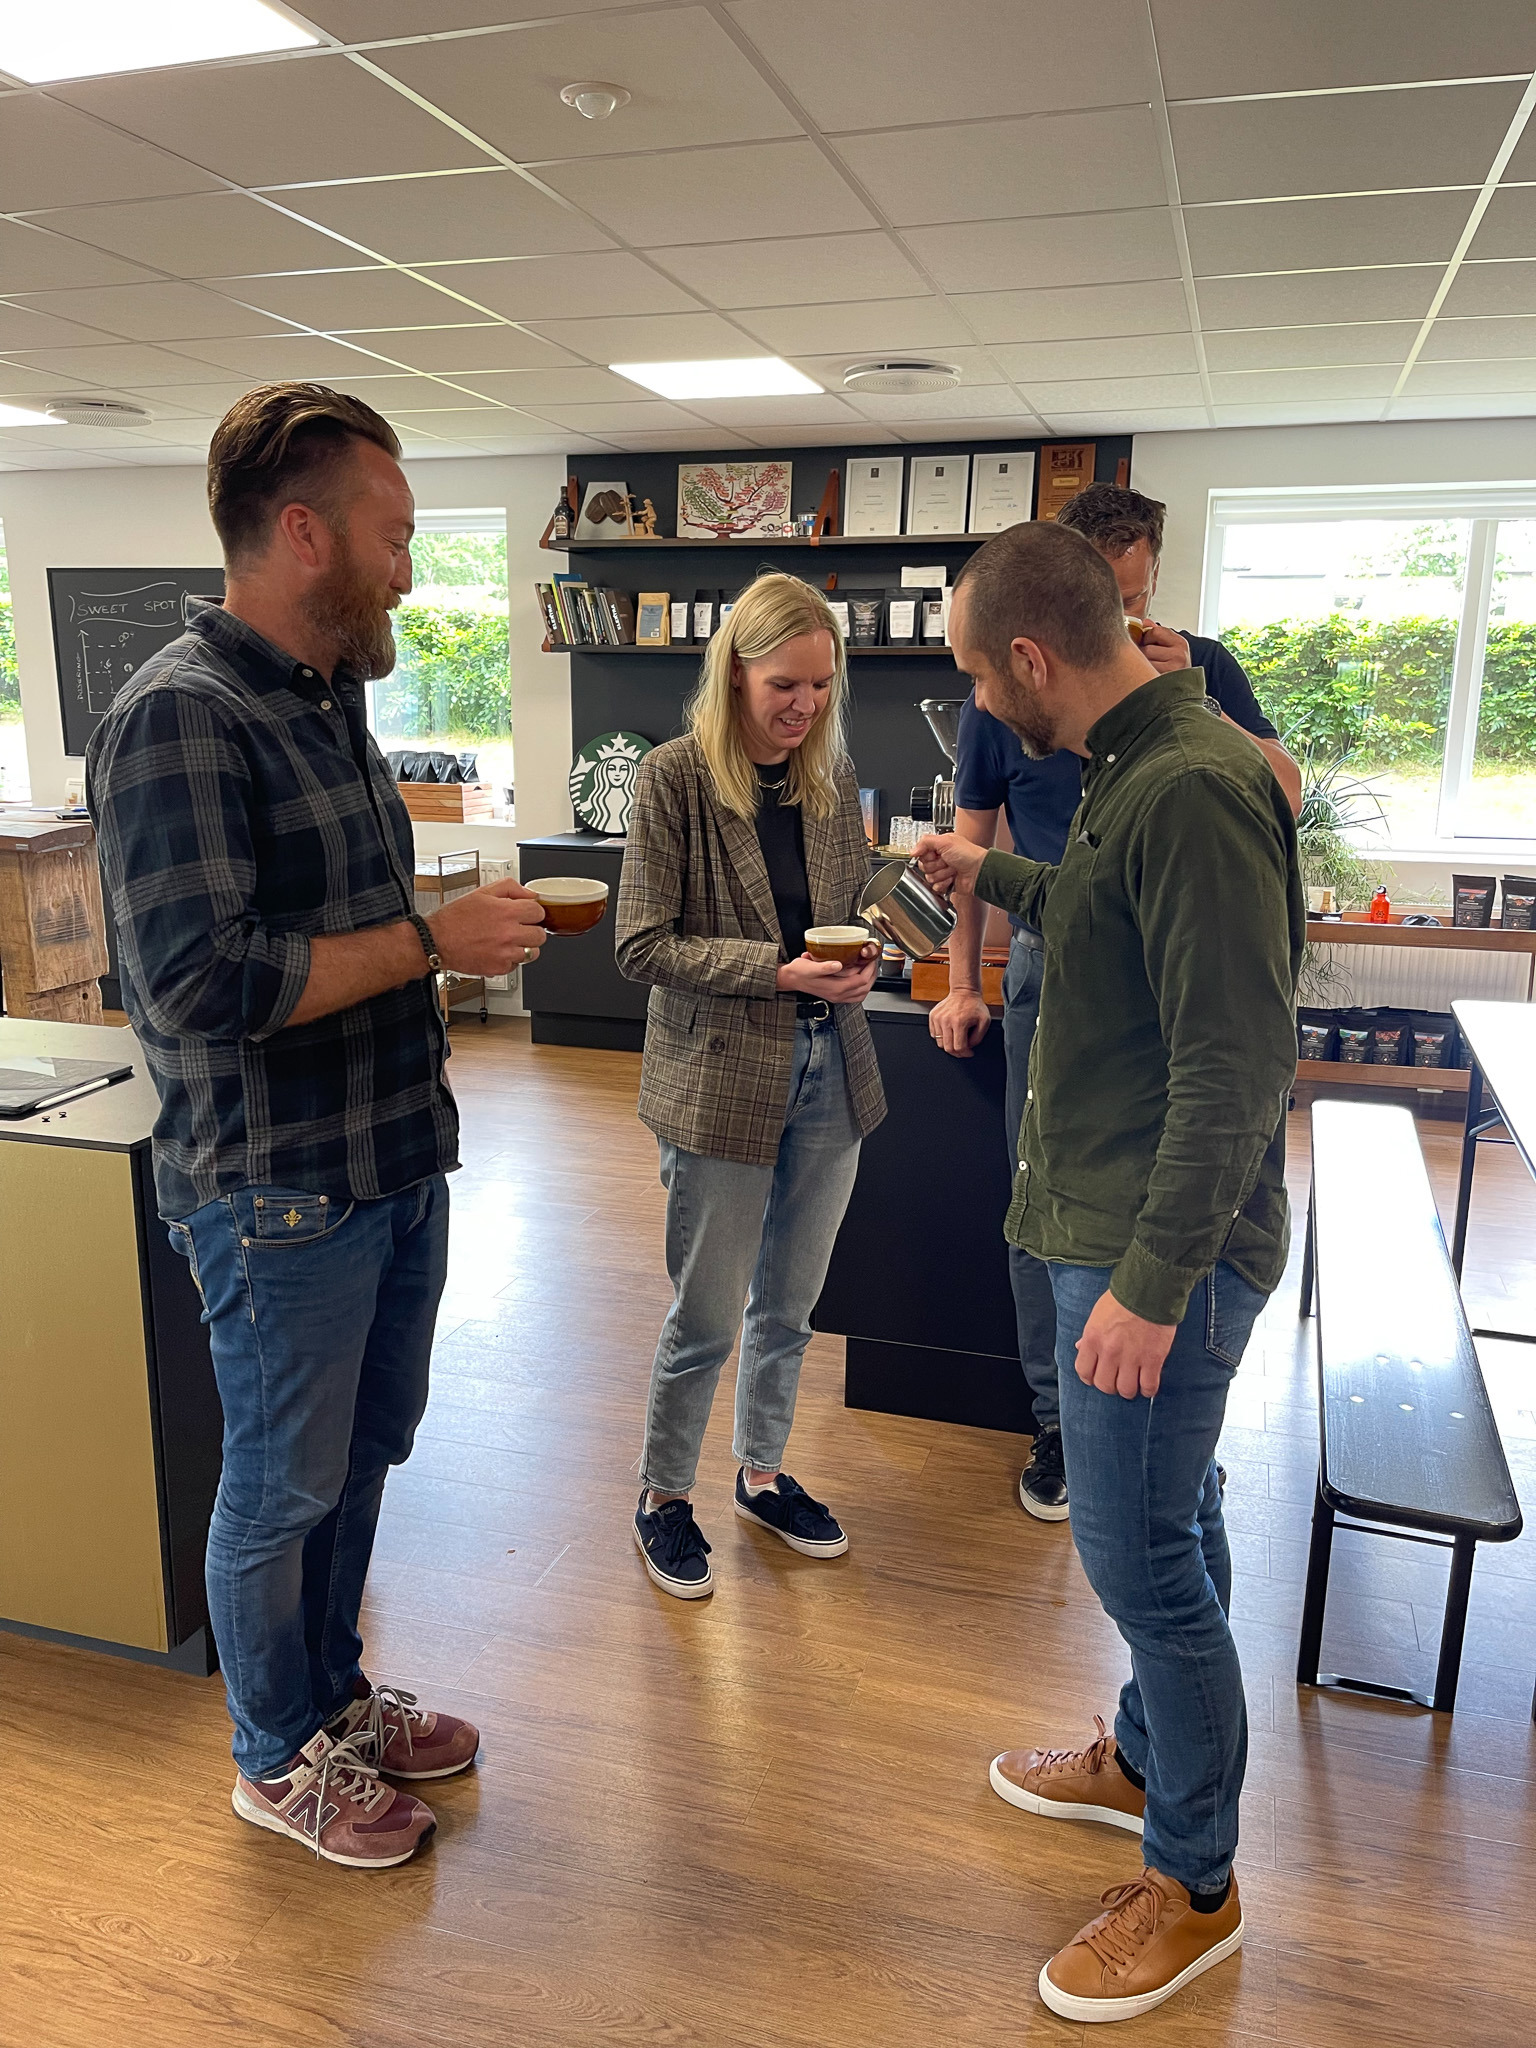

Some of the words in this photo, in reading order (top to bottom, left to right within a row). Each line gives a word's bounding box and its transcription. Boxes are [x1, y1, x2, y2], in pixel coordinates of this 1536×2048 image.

[77, 603, 128, 616] SWEET
[144, 600, 176, 612] SPOT
[287, 1790, 340, 1838] N
